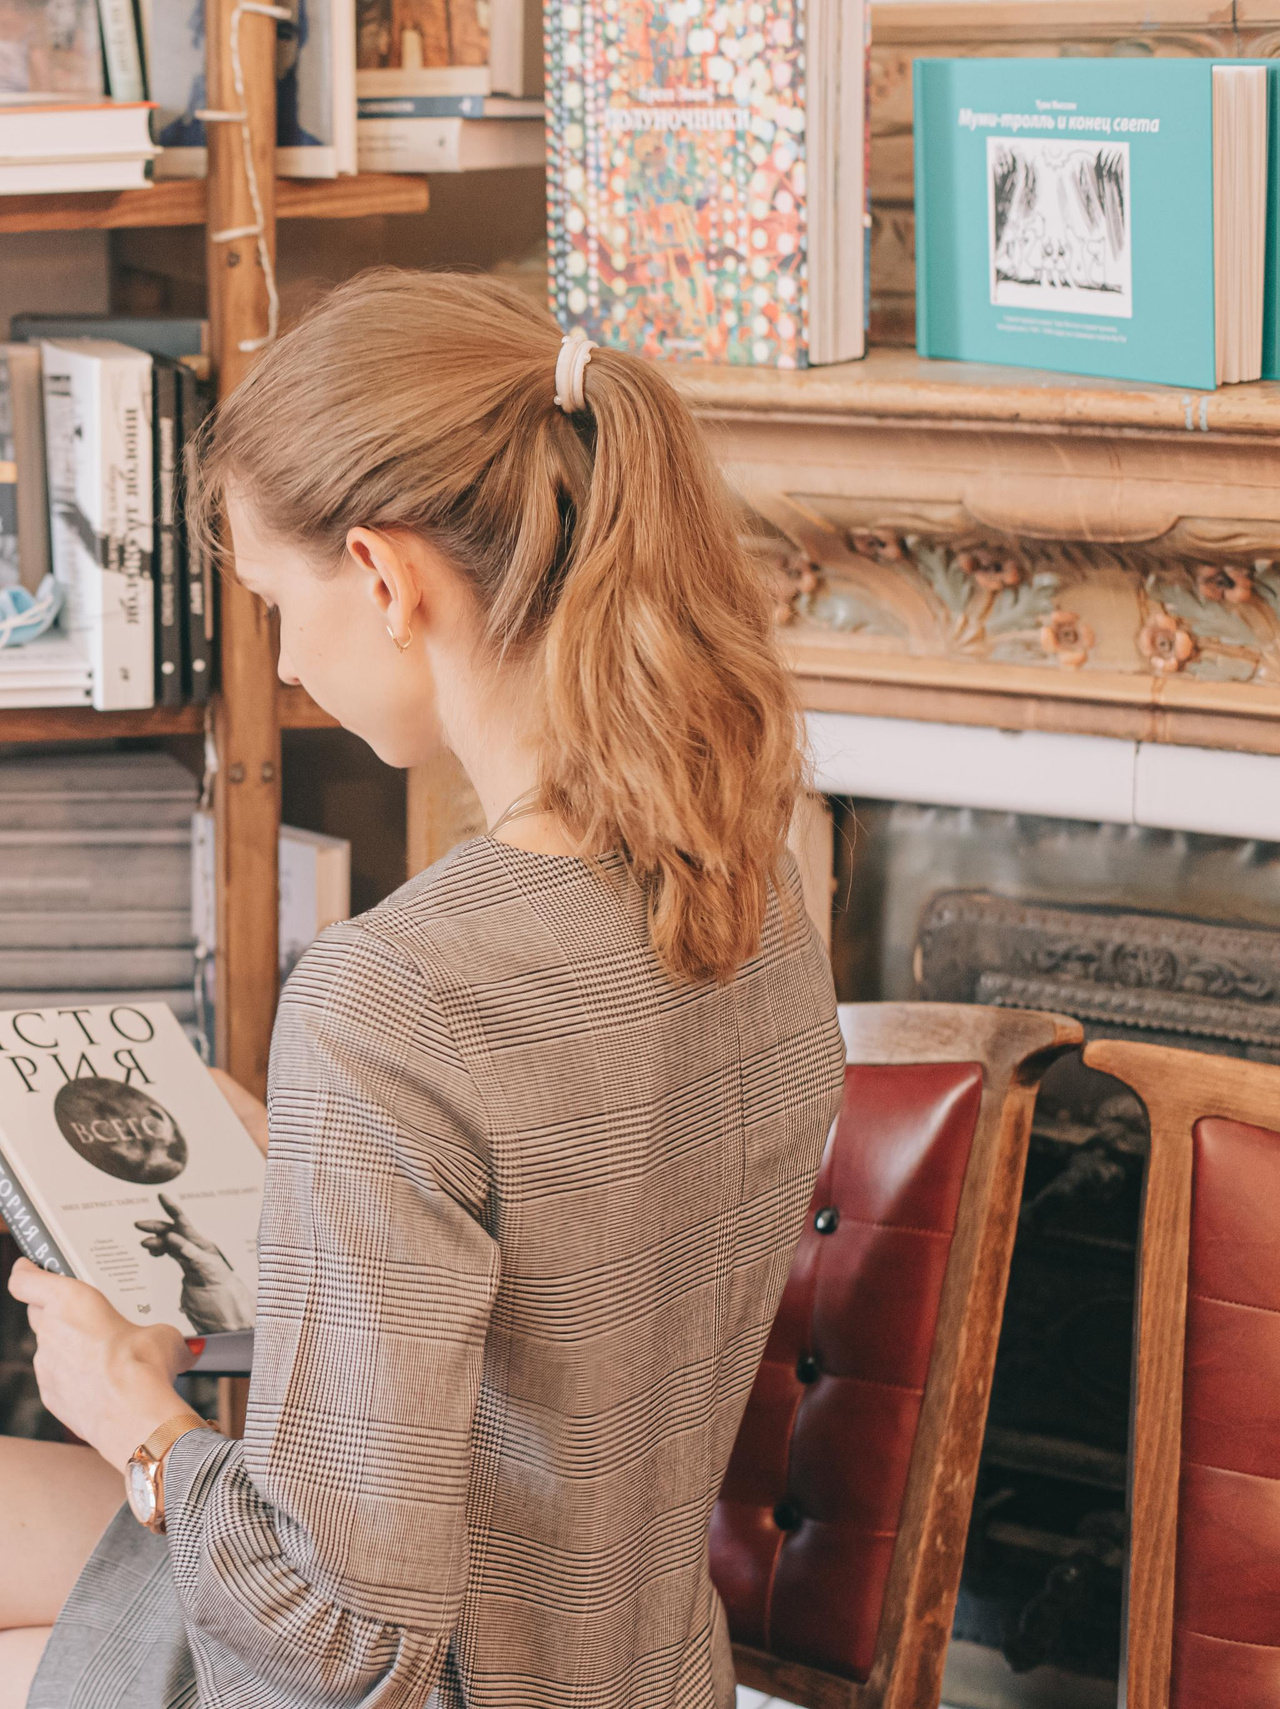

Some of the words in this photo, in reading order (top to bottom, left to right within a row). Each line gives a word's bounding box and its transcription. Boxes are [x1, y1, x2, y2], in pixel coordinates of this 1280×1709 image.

[958, 108, 1055, 132] Муми-тролль
[1057, 115, 1067, 130] и
[1069, 117, 1111, 135] конец
[1113, 117, 1160, 133] света
[6, 1049, 156, 1094] РИЯ
[71, 1114, 170, 1145] ВСЕГО
